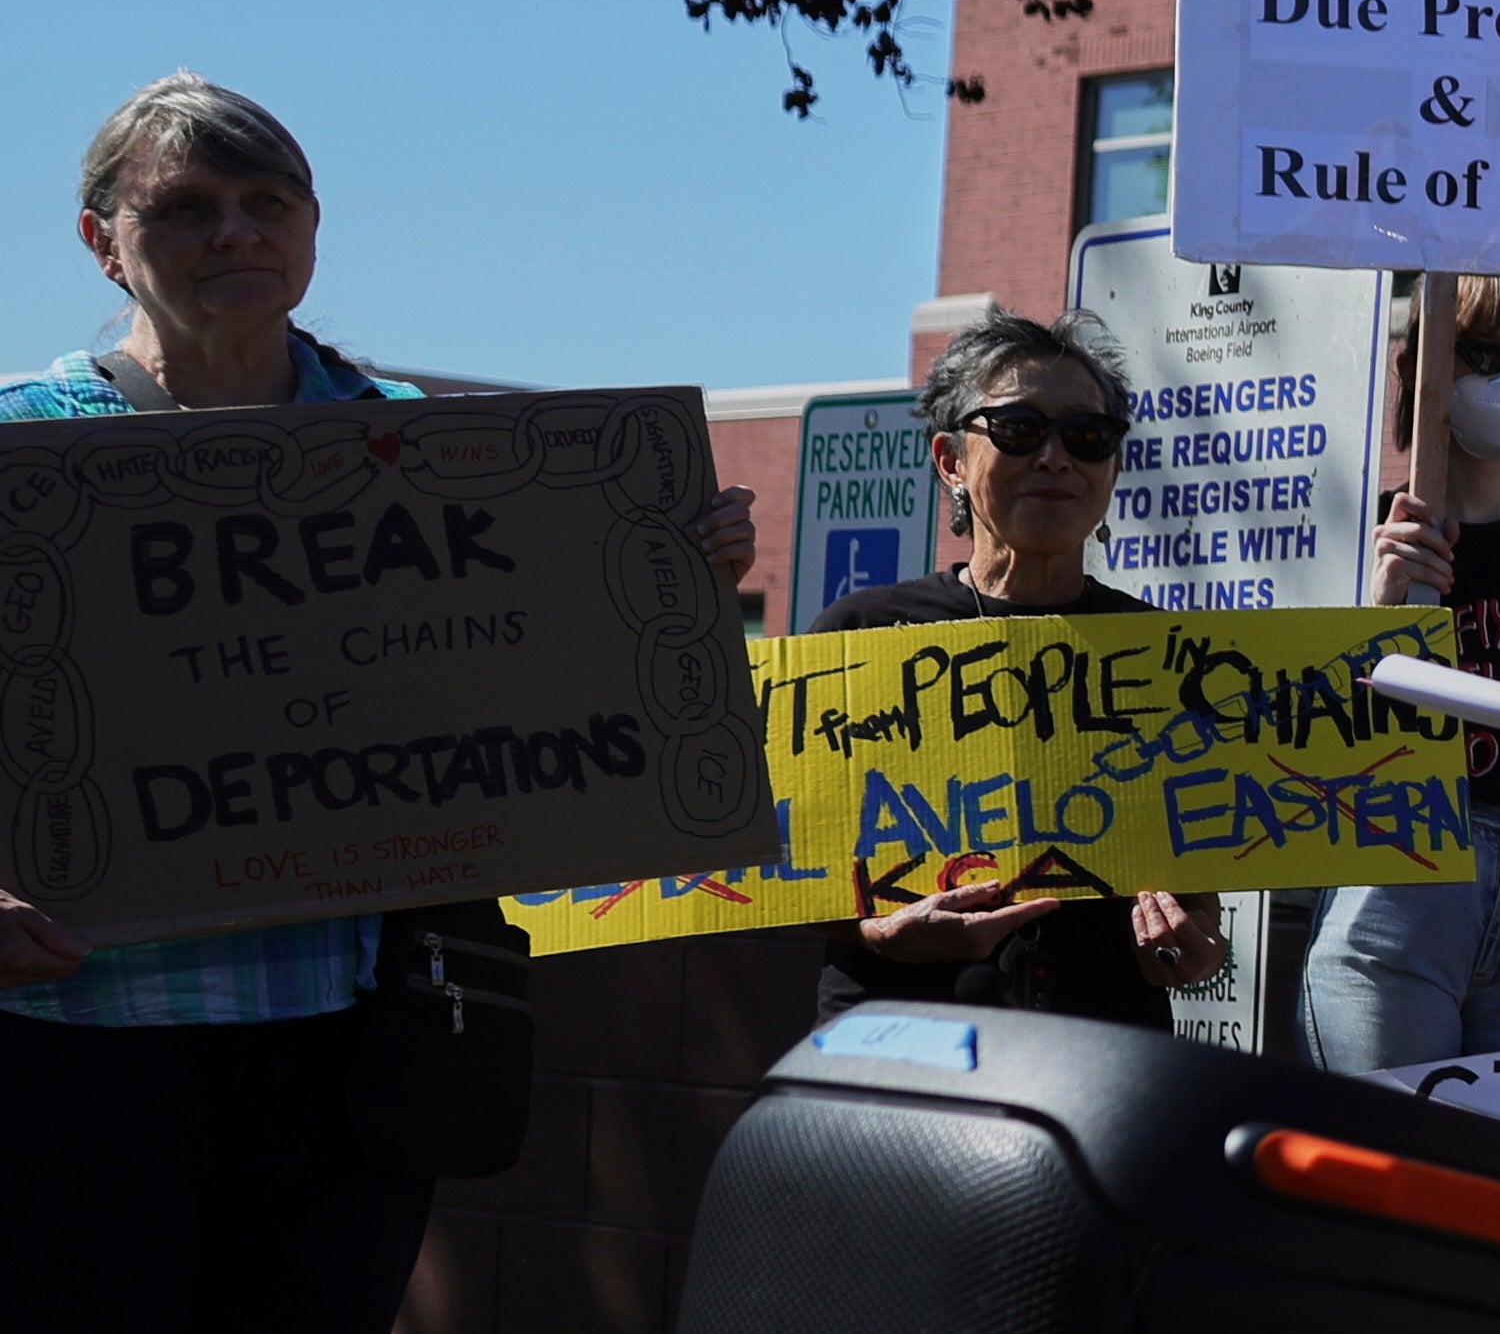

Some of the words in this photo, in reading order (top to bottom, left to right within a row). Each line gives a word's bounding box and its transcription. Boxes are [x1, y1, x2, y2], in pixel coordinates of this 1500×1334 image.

[1419, 75, 1476, 128] &
[1255, 145, 1407, 205] Rule
[1424, 159, 1490, 210] of
[1165, 320, 1234, 344] International
[1236, 317, 1277, 340] Airport
[1190, 302, 1214, 319] King
[1216, 298, 1254, 318] County
[1186, 344, 1223, 363] Boeing
[1226, 340, 1253, 359] Field
[1127, 373, 1317, 422] PASSENGERS
[100, 450, 157, 481] HATE
[310, 452, 344, 478] LOVE
[441, 442, 500, 463] WINS
[641, 408, 675, 506] SIGNATURE
[810, 429, 928, 474] RESERVED
[1119, 437, 1163, 472] RE
[1172, 424, 1328, 468] REQUIRED
[0, 469, 57, 528] ICE
[816, 476, 916, 522] PARKING
[1115, 485, 1150, 520] TO
[1161, 474, 1312, 517] REGISTER
[130, 501, 516, 616] BREAK
[1104, 531, 1229, 571] VEHICLE
[1239, 524, 1317, 563] WITH
[643, 538, 678, 610] AVELO
[1140, 578, 1275, 611] AIRLINES
[5, 571, 45, 635] GEO
[169, 633, 292, 684] THE
[339, 611, 528, 665] CHAINS
[25, 672, 58, 759] AVELO
[284, 690, 352, 728] OF
[901, 641, 1168, 747] PEOPLE
[133, 712, 646, 843] DEPORTATIONS
[696, 746, 724, 804] ICE
[855, 768, 1115, 859] AVELO
[1164, 769, 1473, 859] EASTERN
[212, 849, 315, 890] LOVE
[332, 842, 361, 866] IS
[372, 823, 504, 862] STRONGER
[305, 875, 384, 905] THAN
[406, 860, 481, 894] HATE
